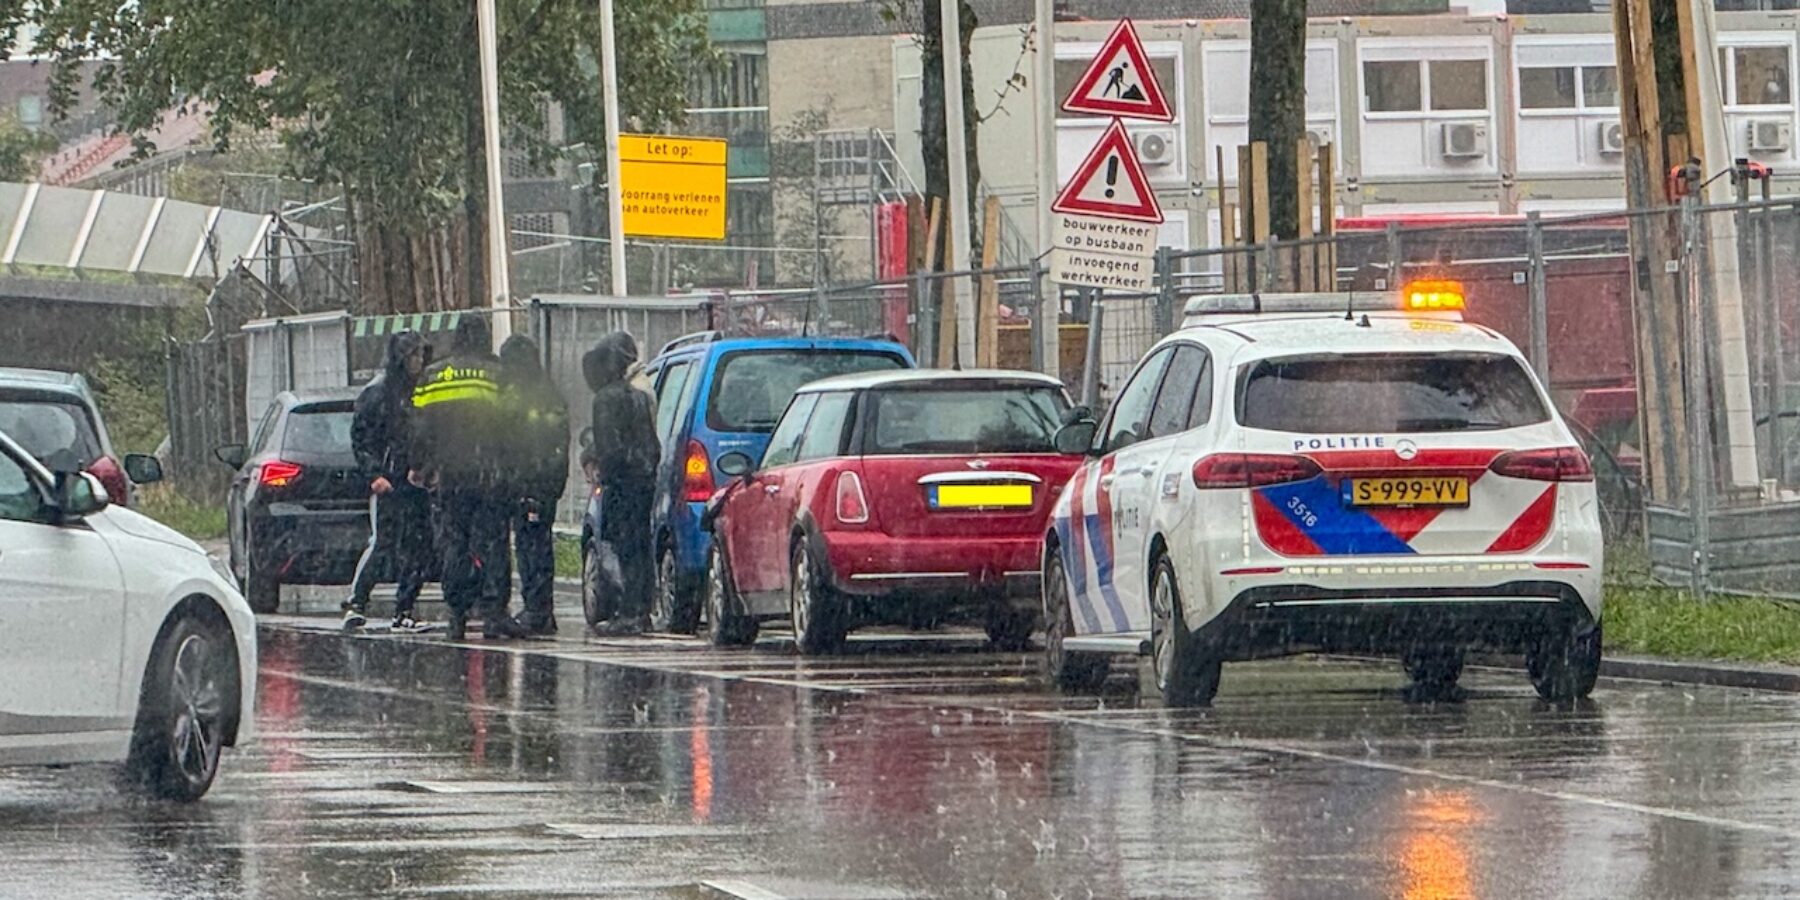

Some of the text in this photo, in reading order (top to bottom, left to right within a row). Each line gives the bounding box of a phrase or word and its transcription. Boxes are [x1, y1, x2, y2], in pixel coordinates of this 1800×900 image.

[647, 142, 693, 158] Let op:
[673, 192, 721, 203] verlenen
[642, 205, 709, 216] autoverkeer
[1063, 218, 1150, 237] bouwverkeer
[1065, 235, 1144, 252] op busbaan
[1069, 255, 1139, 272] invoegend
[1061, 271, 1145, 288] werkverkeer
[1294, 437, 1384, 450] POLITIE
[1359, 480, 1459, 500] S-999-VV
[1287, 496, 1318, 527] 3516
